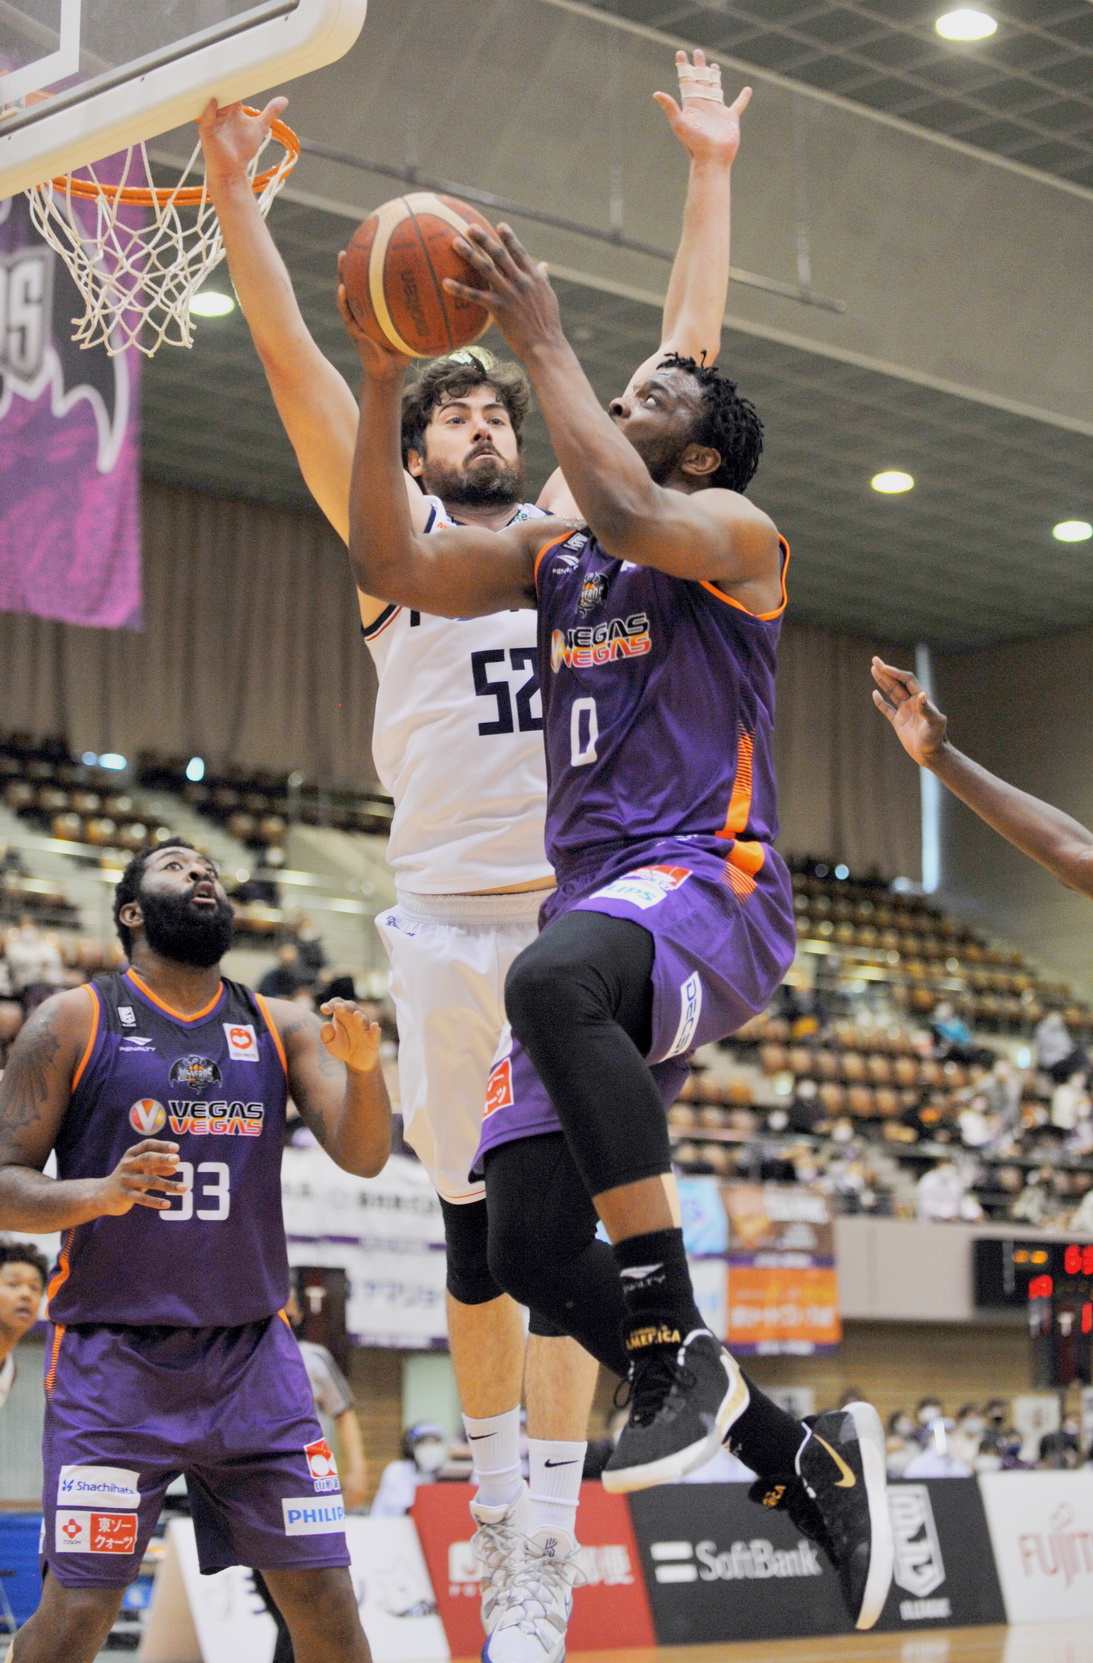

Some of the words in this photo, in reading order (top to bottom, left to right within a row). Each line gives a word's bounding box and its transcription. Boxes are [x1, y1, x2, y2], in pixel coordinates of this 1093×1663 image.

[471, 647, 543, 736] 52
[570, 697, 599, 767] 0
[168, 1100, 263, 1119] VEGAS
[168, 1117, 263, 1136] VEGAS
[159, 1162, 230, 1221] 33
[77, 1481, 135, 1495] Shachihata
[98, 1517, 132, 1532] 東ソー
[95, 1535, 134, 1550] クォーツ
[695, 1539, 823, 1581] SoftBank
